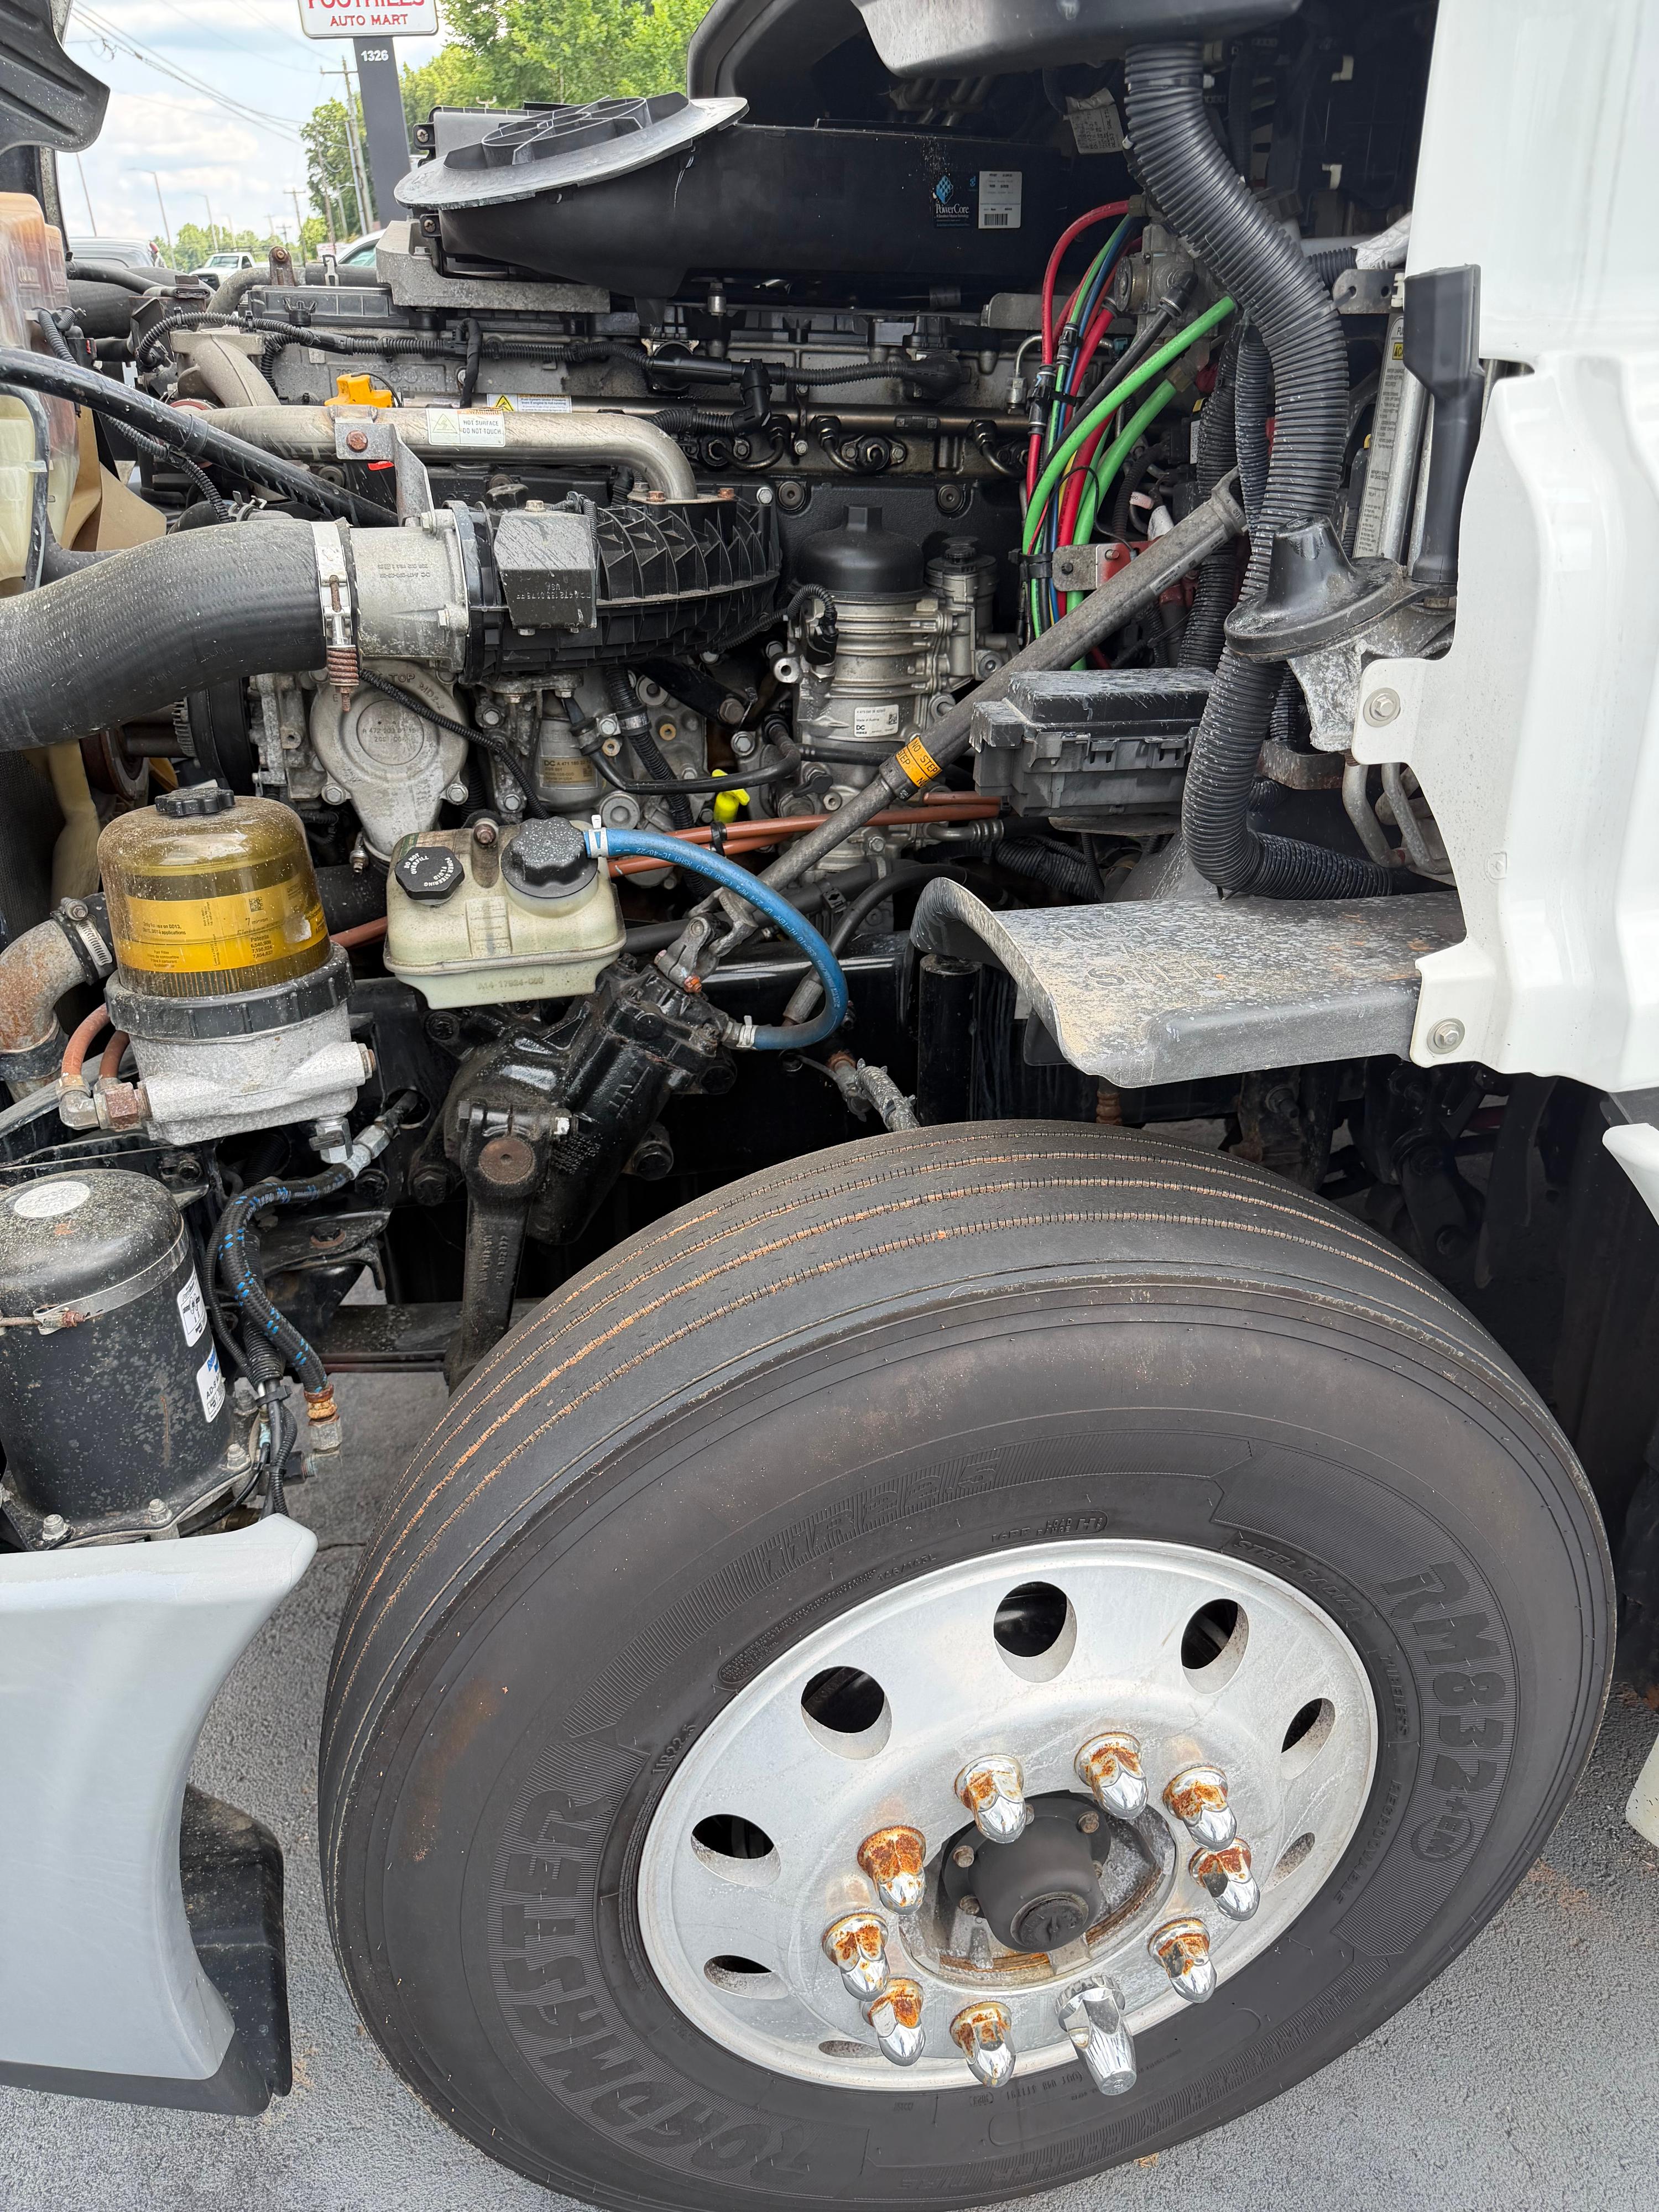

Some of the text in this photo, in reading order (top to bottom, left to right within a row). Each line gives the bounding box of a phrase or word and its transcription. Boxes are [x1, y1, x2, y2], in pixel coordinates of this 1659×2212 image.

[330, 14, 408, 27] AUTO MART
[361, 49, 389, 62] 1326
[936, 204, 970, 215] PowerCore
[389, 673, 415, 683] TOP
[898, 749, 911, 765] STEP
[911, 740, 938, 774] NO STEP
[409, 853, 420, 862] NOT
[674, 857, 693, 867] MSHA
[410, 855, 429, 874] OVERFILL
[424, 857, 454, 887] POWER STEERING
[433, 866, 447, 880] FLUID
[245, 917, 251, 926] 7
[1087, 959, 1221, 987] STEP
[1047, 1518, 1072, 1529] LOAD
[1036, 1526, 1071, 1536] RANGE
[1234, 1540, 1296, 1568] STEEL
[651, 1725, 696, 1774] 11R22.5
